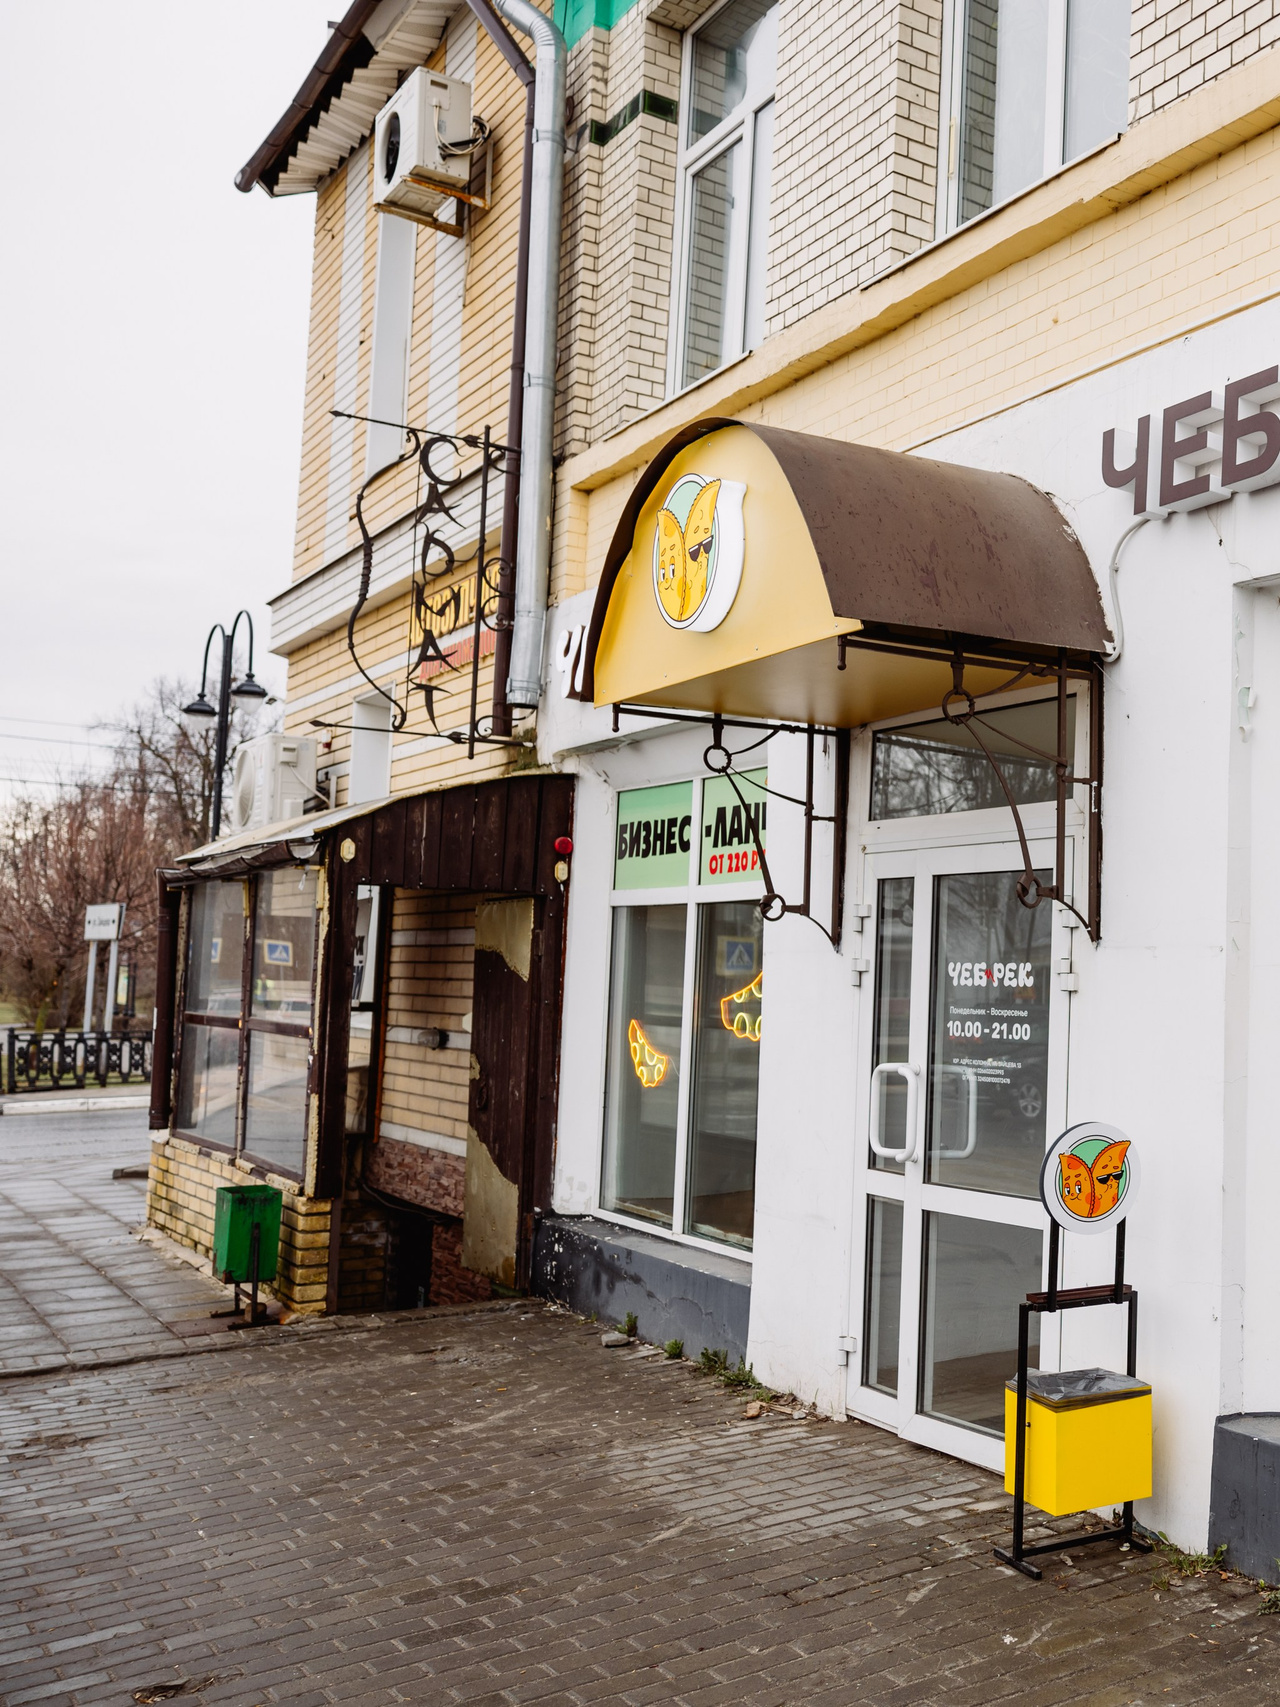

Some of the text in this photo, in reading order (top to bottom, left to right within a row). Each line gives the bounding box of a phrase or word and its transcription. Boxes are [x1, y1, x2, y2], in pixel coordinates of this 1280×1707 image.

[709, 854, 724, 875] ОТ
[727, 850, 748, 874] 220
[949, 1005, 986, 1016] Понедельник
[991, 1007, 1028, 1018] Воскресенье
[947, 1020, 982, 1038] 10.00
[991, 1022, 1031, 1040] 21.00
